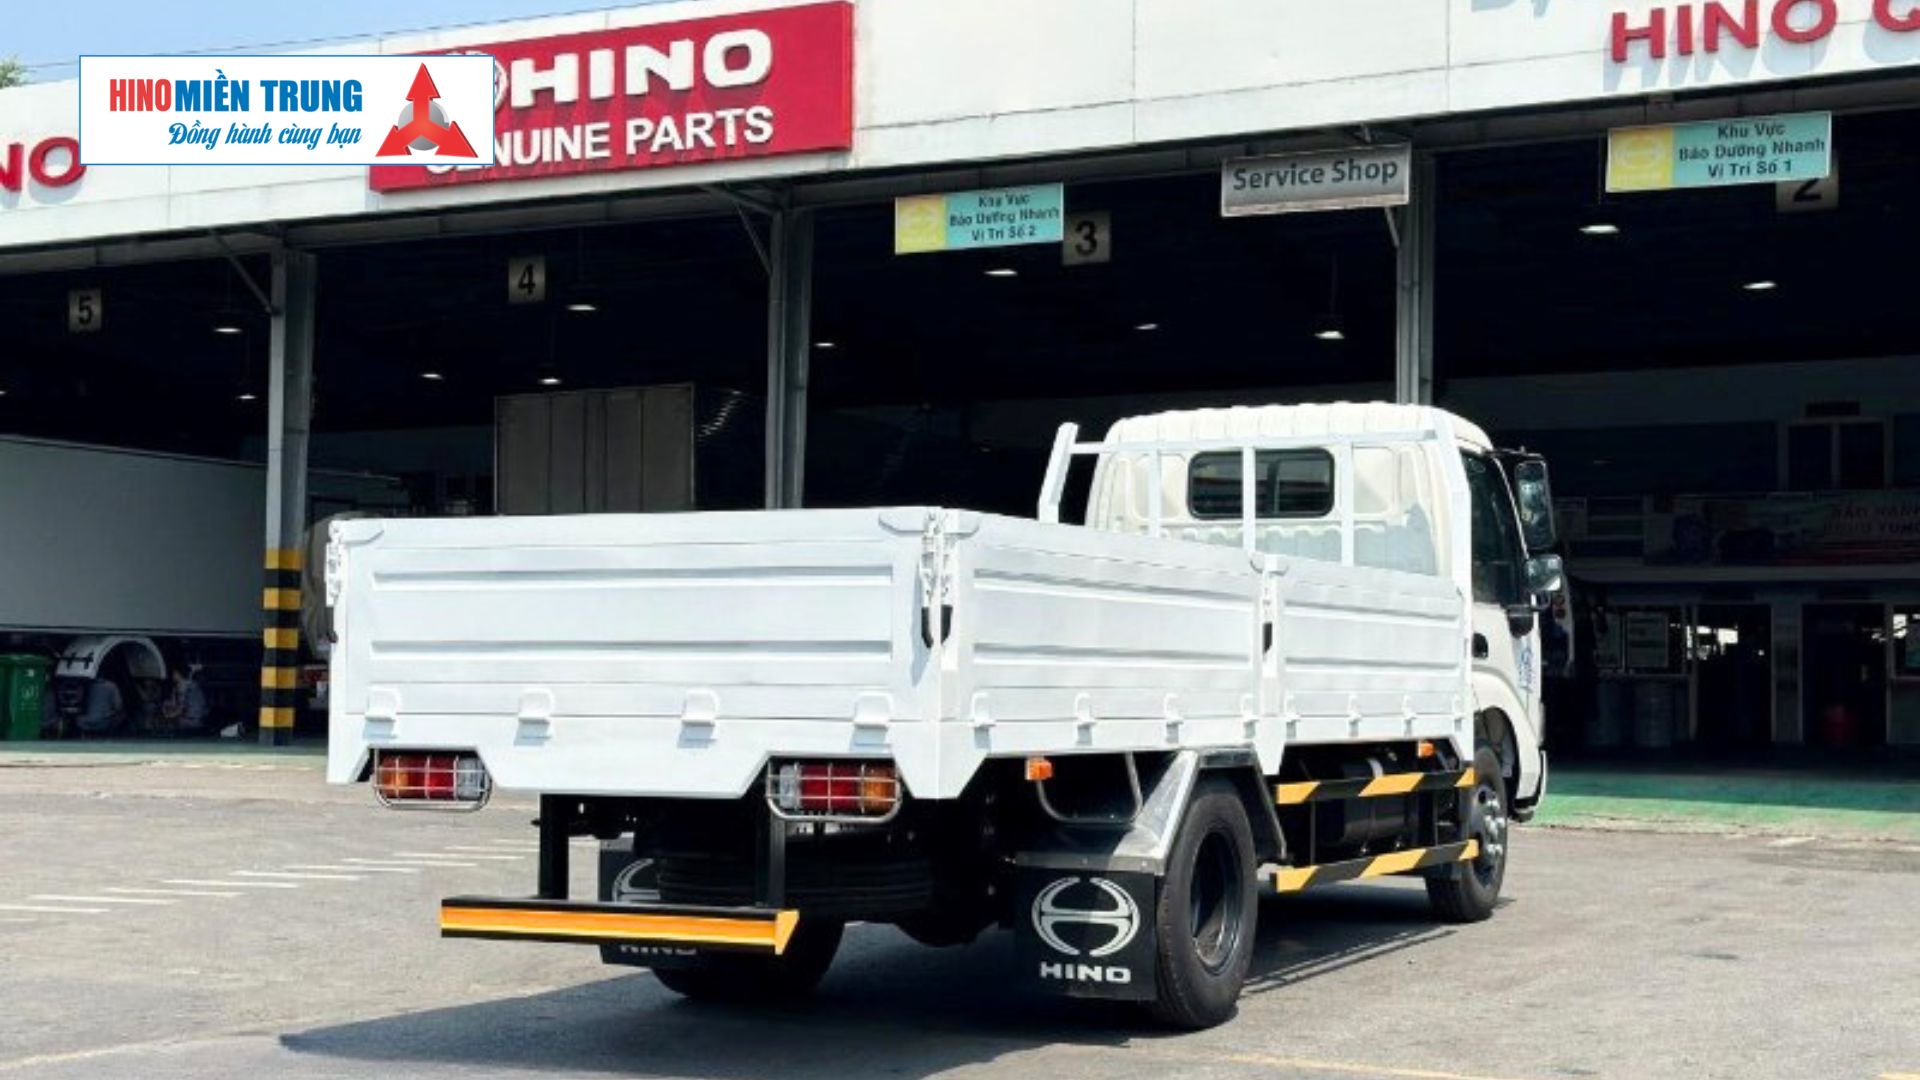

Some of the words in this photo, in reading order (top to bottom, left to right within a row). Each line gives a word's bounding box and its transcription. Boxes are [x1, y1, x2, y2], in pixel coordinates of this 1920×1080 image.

[1611, 0, 1838, 63] HINO
[511, 28, 773, 109] HINO
[626, 105, 774, 156] PARTS
[1718, 122, 1748, 139] Khu
[1773, 137, 1825, 155] Nhanh
[1233, 163, 1325, 191] Service
[1331, 157, 1398, 185] Shop
[1783, 160, 1792, 172] 1
[1028, 224, 1036, 237] 2
[1075, 220, 1097, 256] 3
[518, 263, 536, 295] 4
[79, 296, 92, 325] 5
[1040, 961, 1131, 984] HINO
